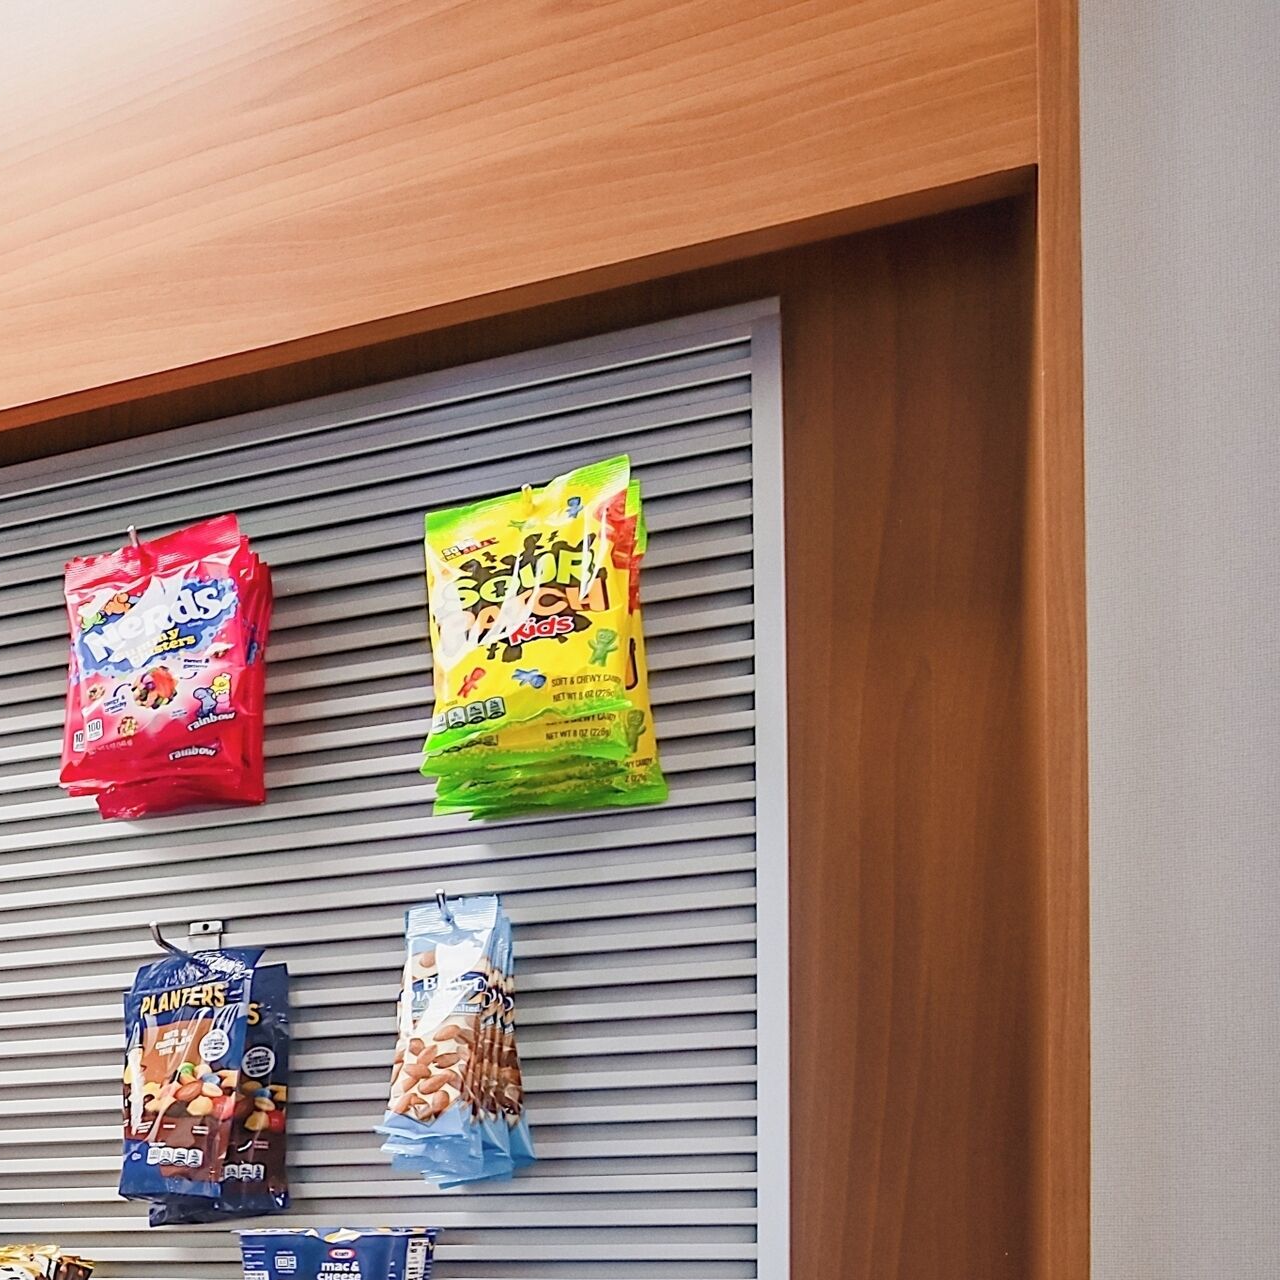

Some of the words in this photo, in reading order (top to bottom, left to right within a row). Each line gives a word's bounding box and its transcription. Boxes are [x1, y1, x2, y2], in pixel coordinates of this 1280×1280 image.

[509, 616, 575, 647] Kids
[551, 677, 568, 688] SOFT
[187, 710, 236, 732] rainbow
[546, 732, 559, 741] NET
[560, 730, 572, 739] WT
[168, 745, 217, 762] rainbow
[140, 984, 227, 1019] PLANTERS
[321, 1261, 349, 1271] mac
[350, 1261, 360, 1272] &
